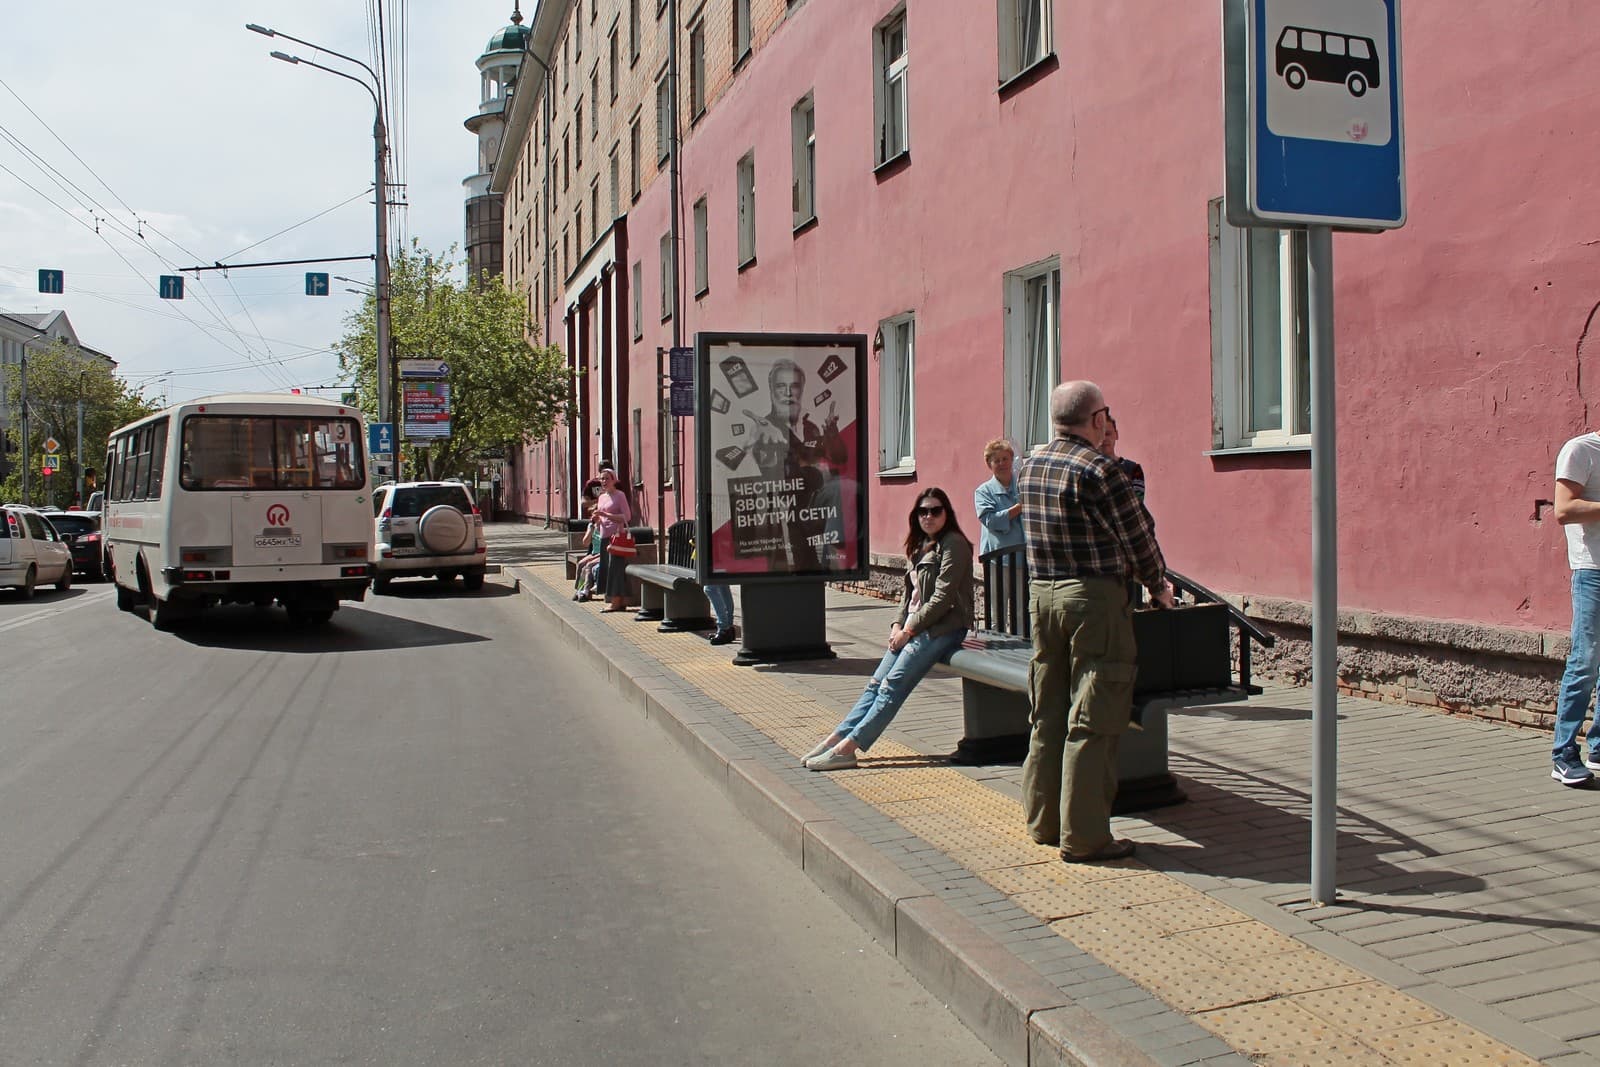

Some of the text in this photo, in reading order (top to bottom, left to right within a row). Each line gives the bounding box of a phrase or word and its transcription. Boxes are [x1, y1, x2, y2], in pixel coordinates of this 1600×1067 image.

[336, 424, 346, 440] 9
[734, 478, 805, 496] ЧЕСТНЫЕ
[736, 494, 796, 512] ЗВОНКИ
[737, 506, 837, 528] ВНУТРИ СЕТИ
[806, 530, 839, 547] TELE2
